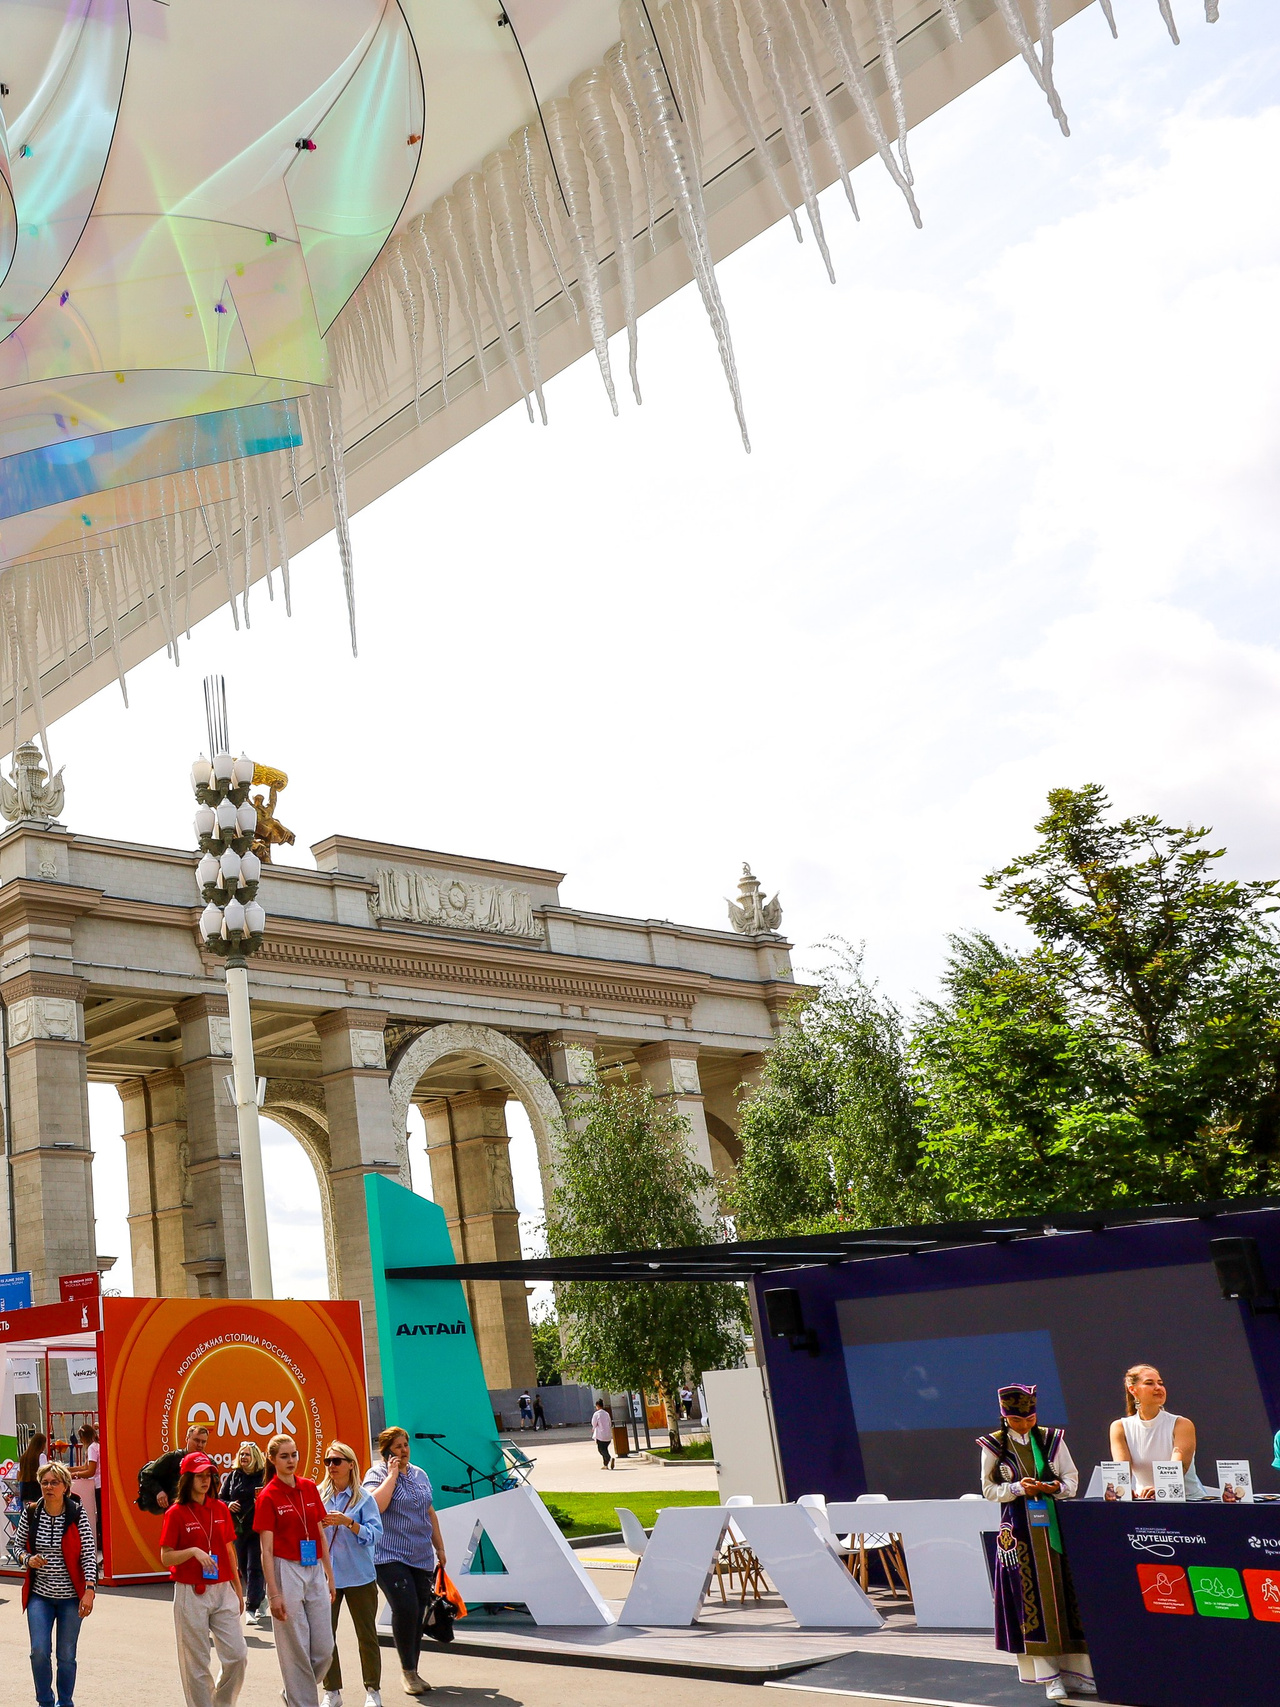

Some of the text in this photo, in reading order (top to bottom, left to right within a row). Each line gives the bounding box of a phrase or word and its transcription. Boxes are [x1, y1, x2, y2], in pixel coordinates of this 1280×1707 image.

[176, 1333, 307, 1385] МОЛОДЁЖНАЯ СТОЛИЦА РОССИИ-2025
[161, 1387, 176, 1453] ОССИИ-2025
[187, 1400, 298, 1437] ОМСК
[1136, 1534, 1206, 1544] ПУТЕШЕСТВУЙ!
